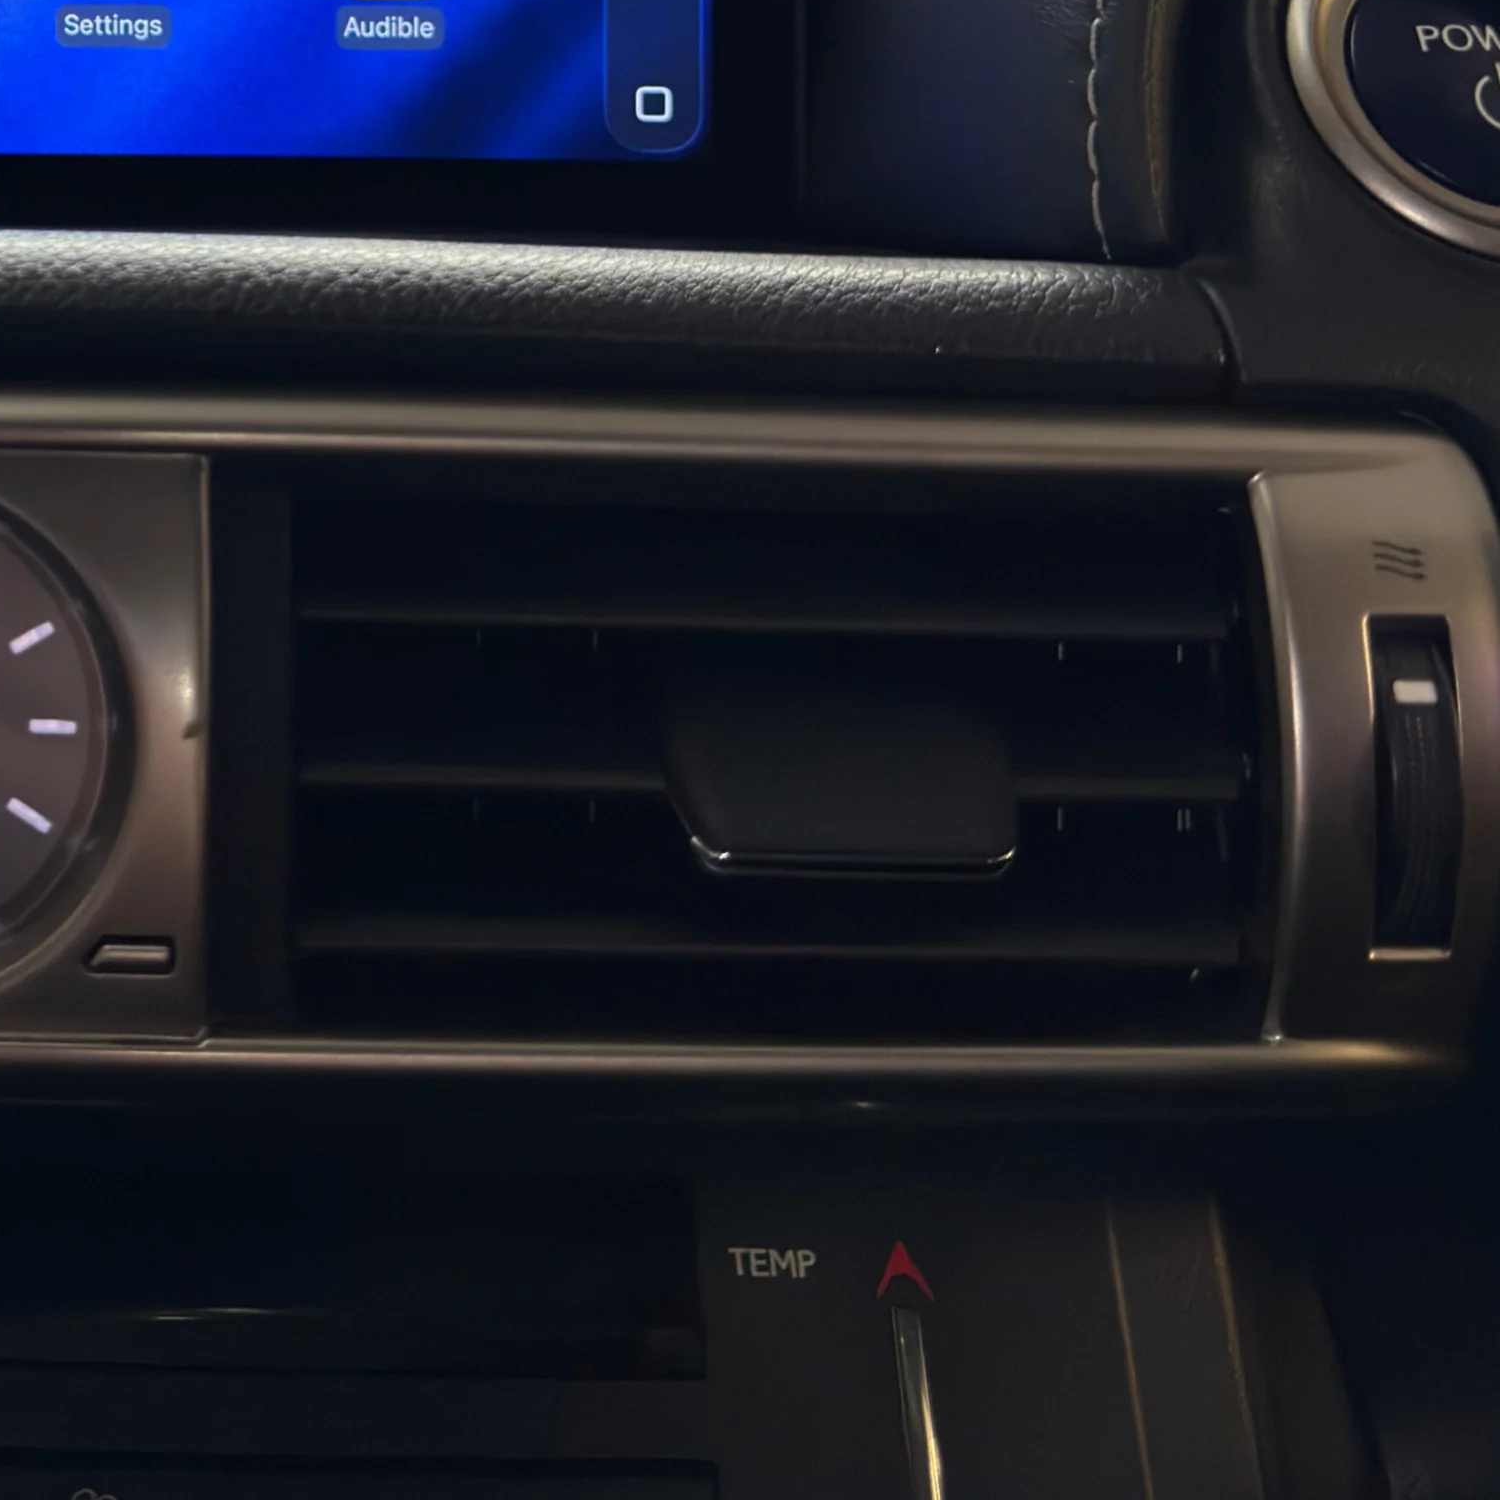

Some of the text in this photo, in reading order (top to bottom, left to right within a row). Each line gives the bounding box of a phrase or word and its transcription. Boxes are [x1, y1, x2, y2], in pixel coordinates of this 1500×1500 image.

[63, 14, 163, 41] Settings
[343, 16, 435, 40] Audible
[728, 1246, 817, 1280] TEMP
